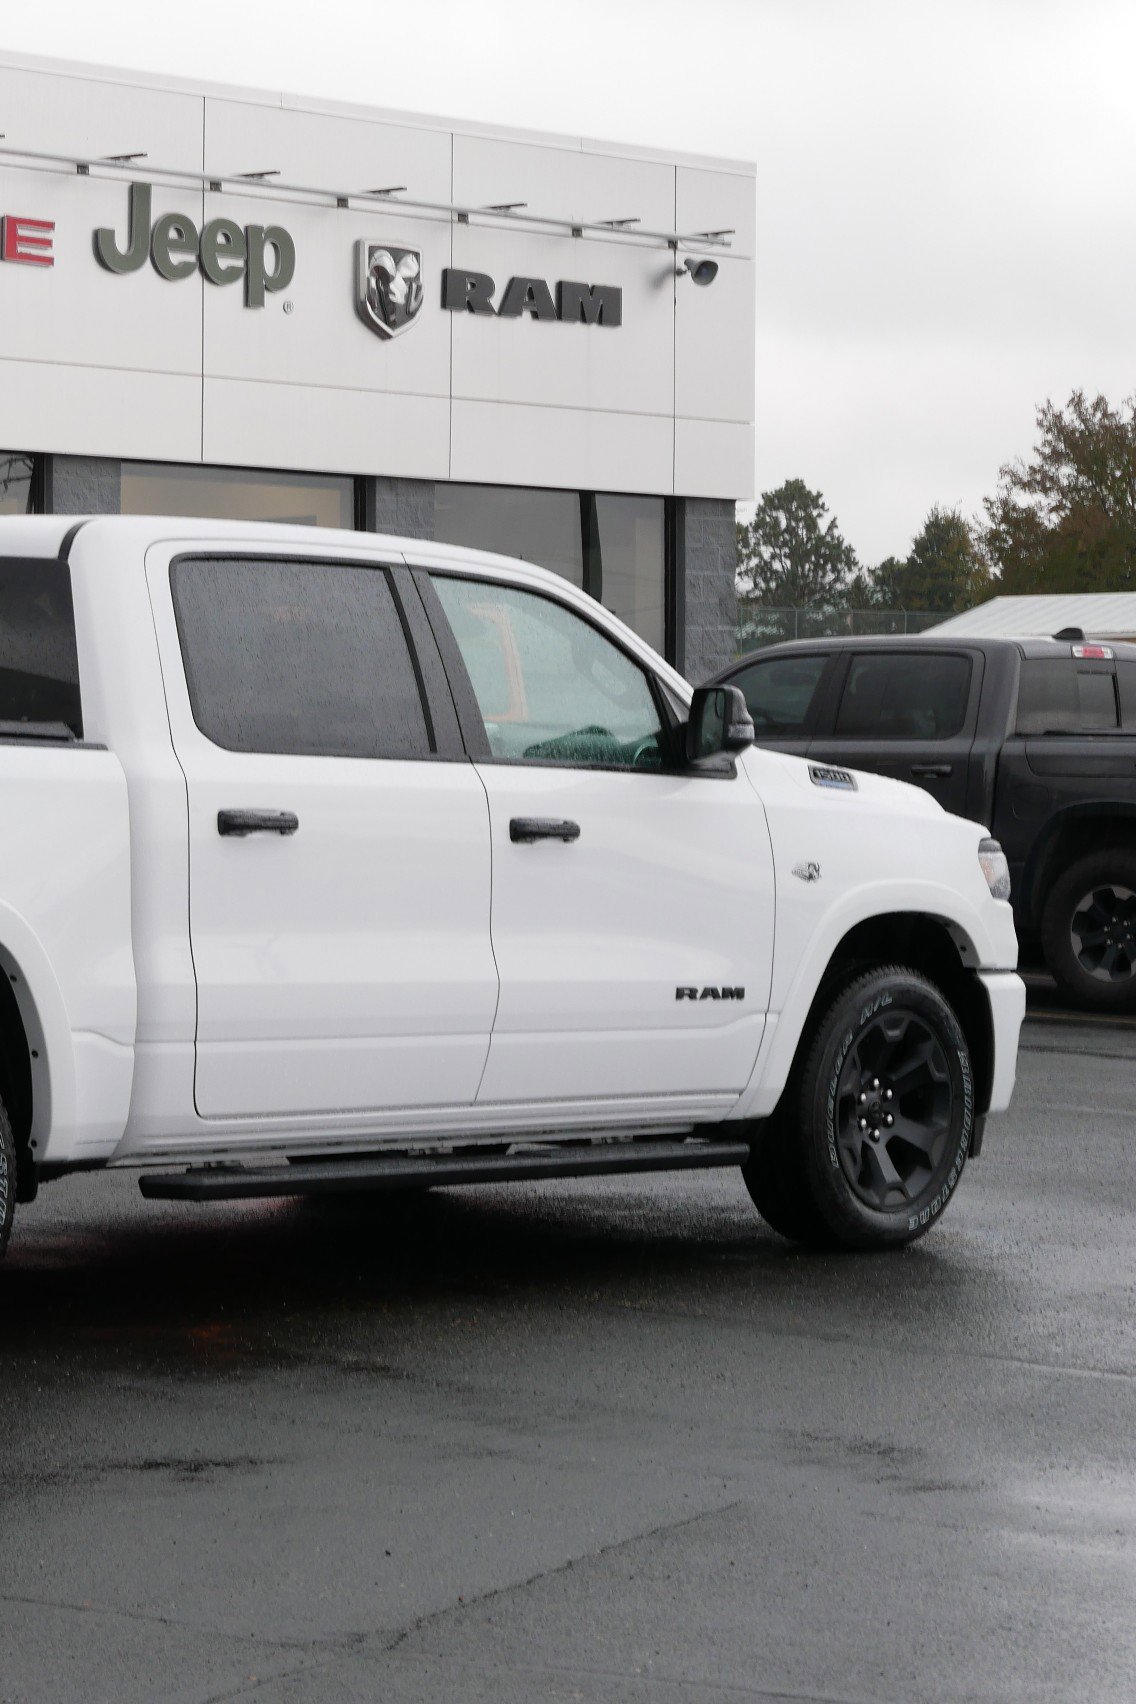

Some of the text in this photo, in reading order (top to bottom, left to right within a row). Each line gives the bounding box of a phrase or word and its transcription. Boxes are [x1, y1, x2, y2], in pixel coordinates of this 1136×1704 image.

[94, 182, 295, 308] Jeep
[441, 268, 623, 327] RAM
[675, 986, 745, 1002] RAM
